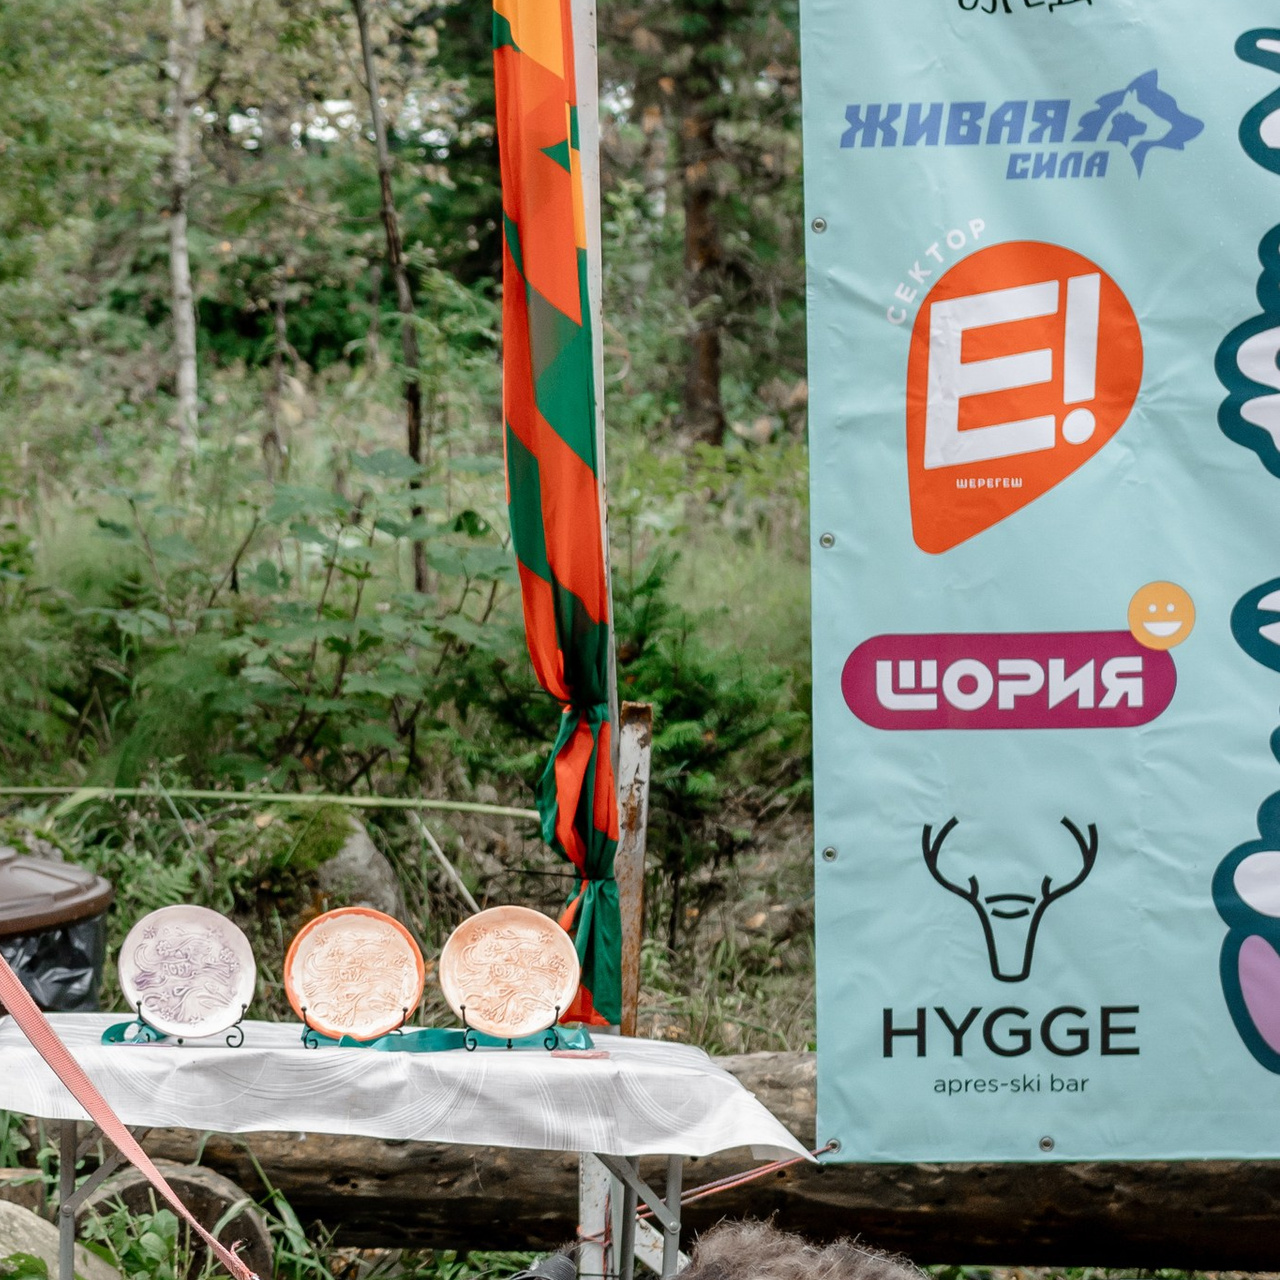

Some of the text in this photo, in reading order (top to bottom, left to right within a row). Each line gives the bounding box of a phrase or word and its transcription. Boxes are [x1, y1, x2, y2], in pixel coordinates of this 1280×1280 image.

[839, 99, 1071, 148] ЖИВАЯ
[1005, 150, 1110, 180] СИЛА
[886, 218, 986, 325] СЕКТОР
[955, 477, 1023, 489] ШЕРЕГЕШ
[875, 656, 1144, 711] ШОРИЯ
[883, 1005, 1140, 1058] HYGGE
[933, 1074, 1090, 1097] apres-ski bar
